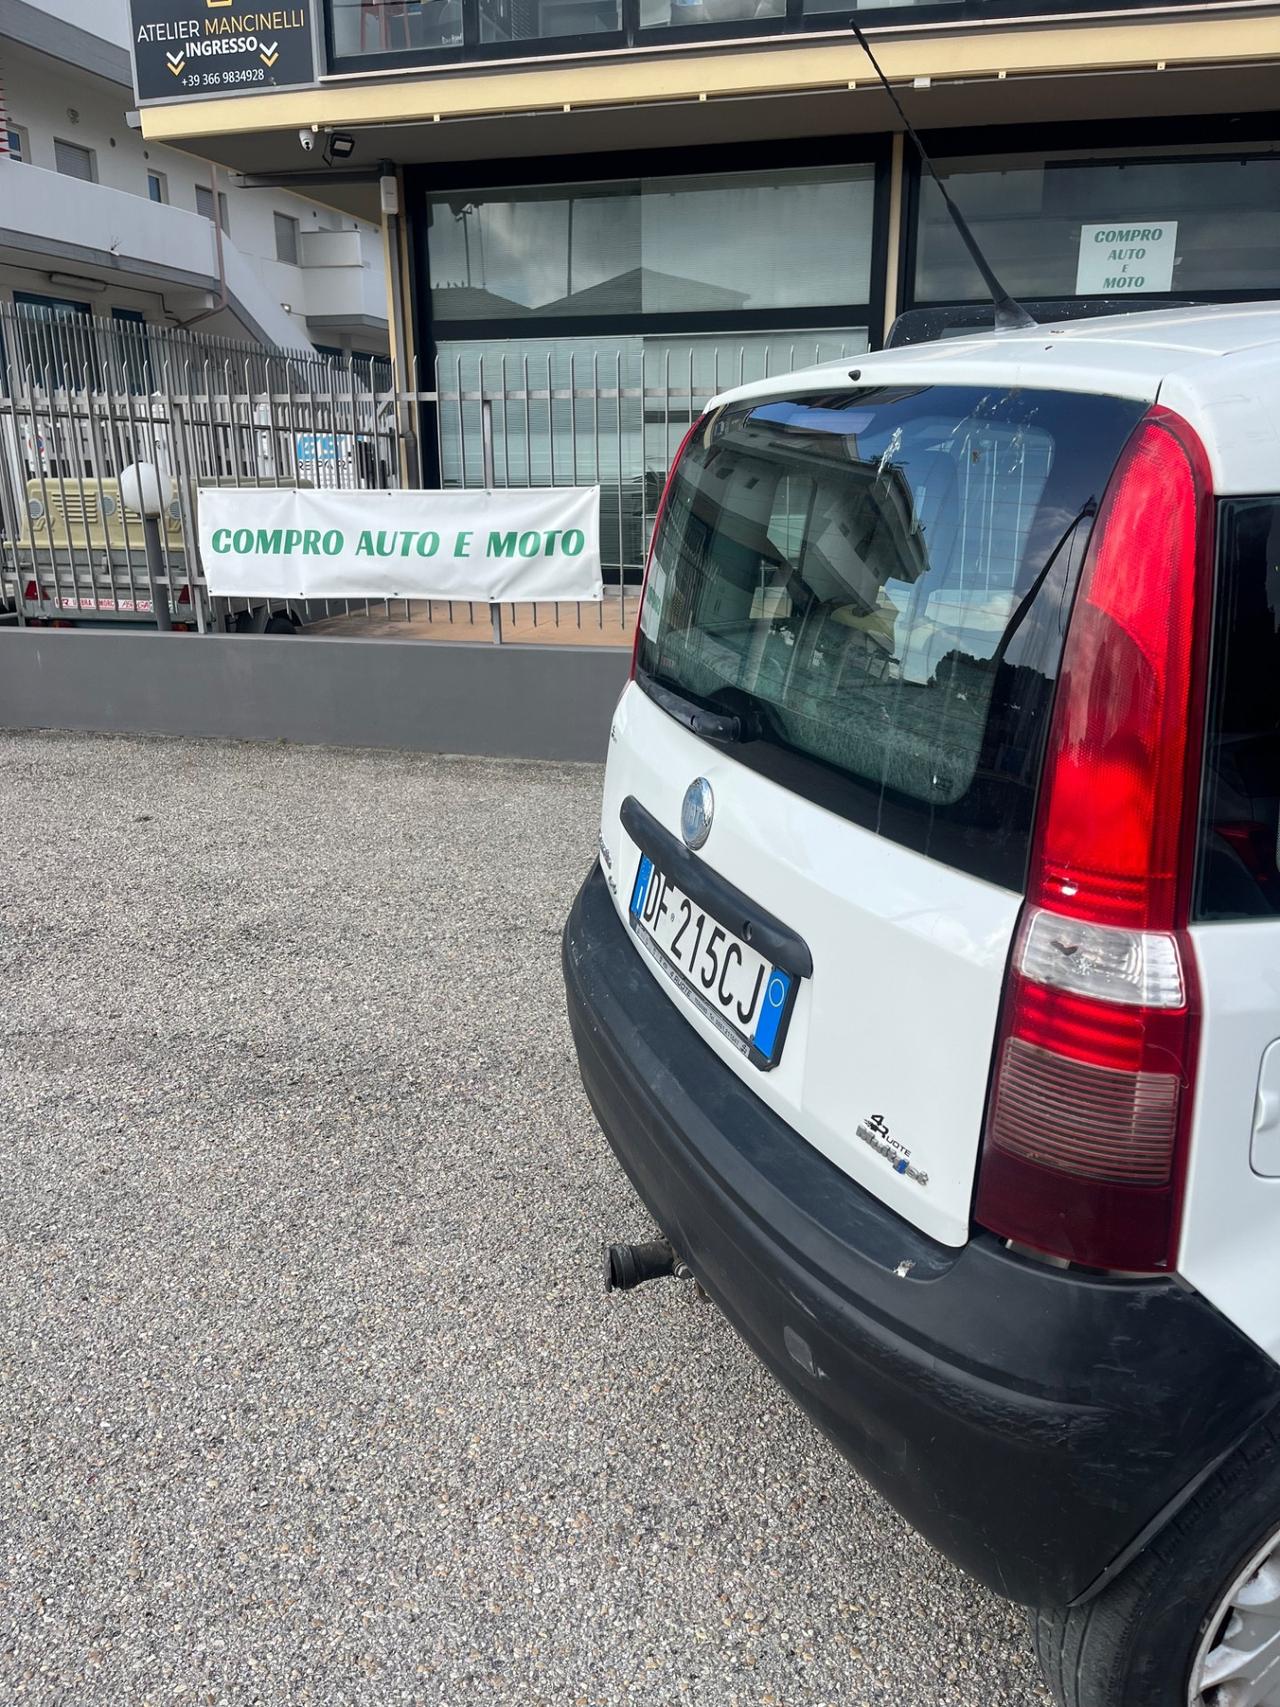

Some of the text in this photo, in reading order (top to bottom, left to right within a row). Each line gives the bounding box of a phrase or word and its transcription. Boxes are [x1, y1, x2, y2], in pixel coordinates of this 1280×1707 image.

[137, 9, 304, 43] ATELIER MANCINELLI
[185, 36, 258, 58] INGRESSO
[182, 68, 265, 87] +39 366 9834928
[1094, 228, 1163, 243] COMPRO
[1108, 248, 1146, 261] AUTO
[1121, 263, 1129, 273] E
[1102, 276, 1145, 289] MOTO
[211, 528, 585, 558] COMPRO AUTO E MOTO
[643, 871, 675, 932] DF
[670, 898, 766, 1025] 215CJ
